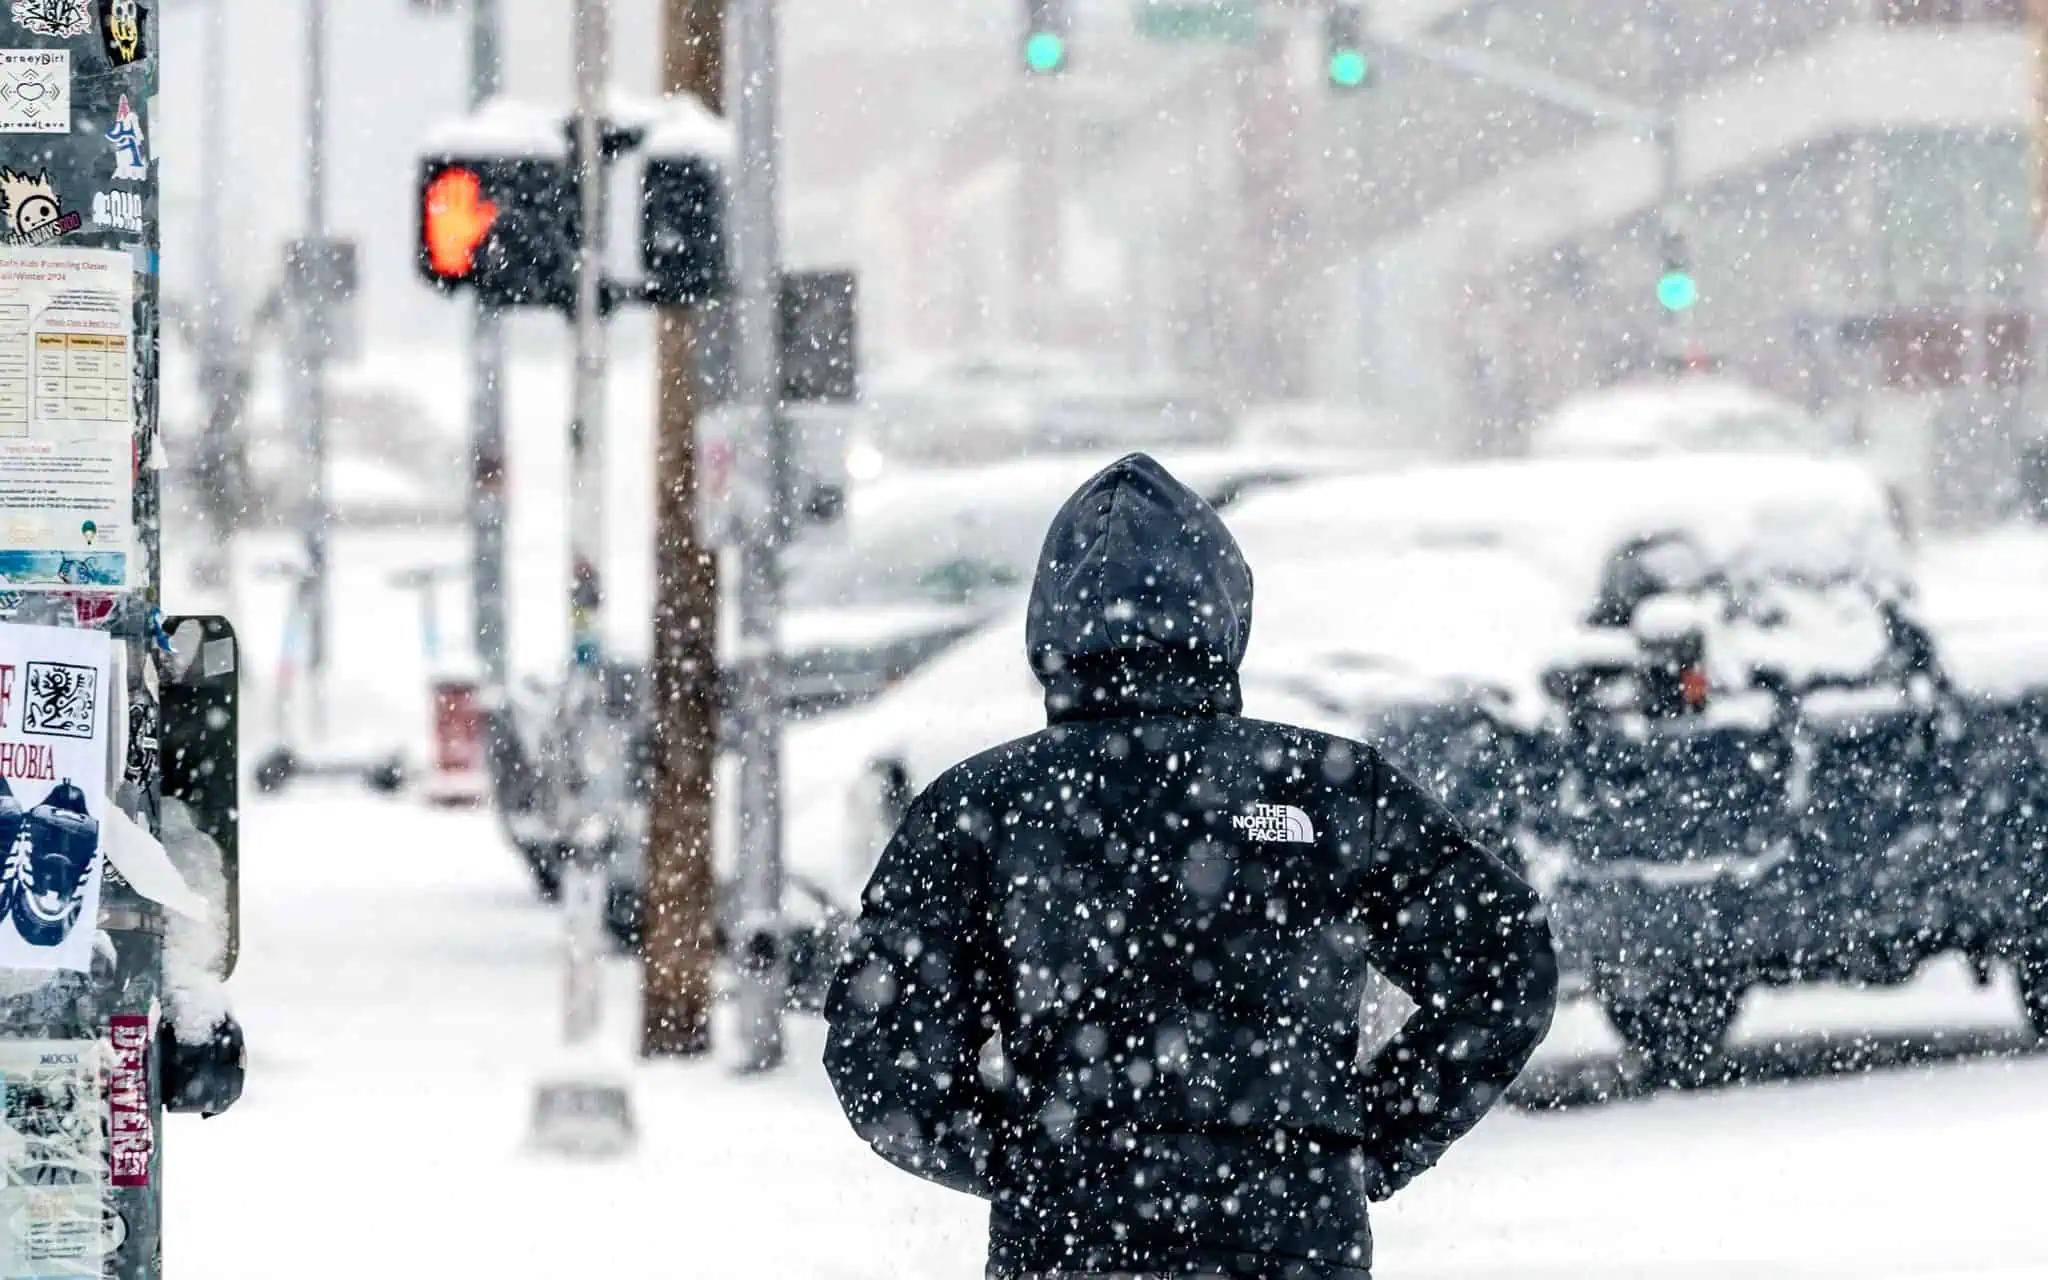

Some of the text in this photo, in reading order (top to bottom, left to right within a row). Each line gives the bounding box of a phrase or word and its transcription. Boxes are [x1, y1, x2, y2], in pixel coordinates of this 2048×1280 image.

[0, 119, 65, 130] preadLove
[1255, 804, 1287, 817] THE
[1232, 816, 1287, 829] NORTH
[1248, 828, 1287, 842] FACE
[112, 1025, 147, 1152] DENVER
